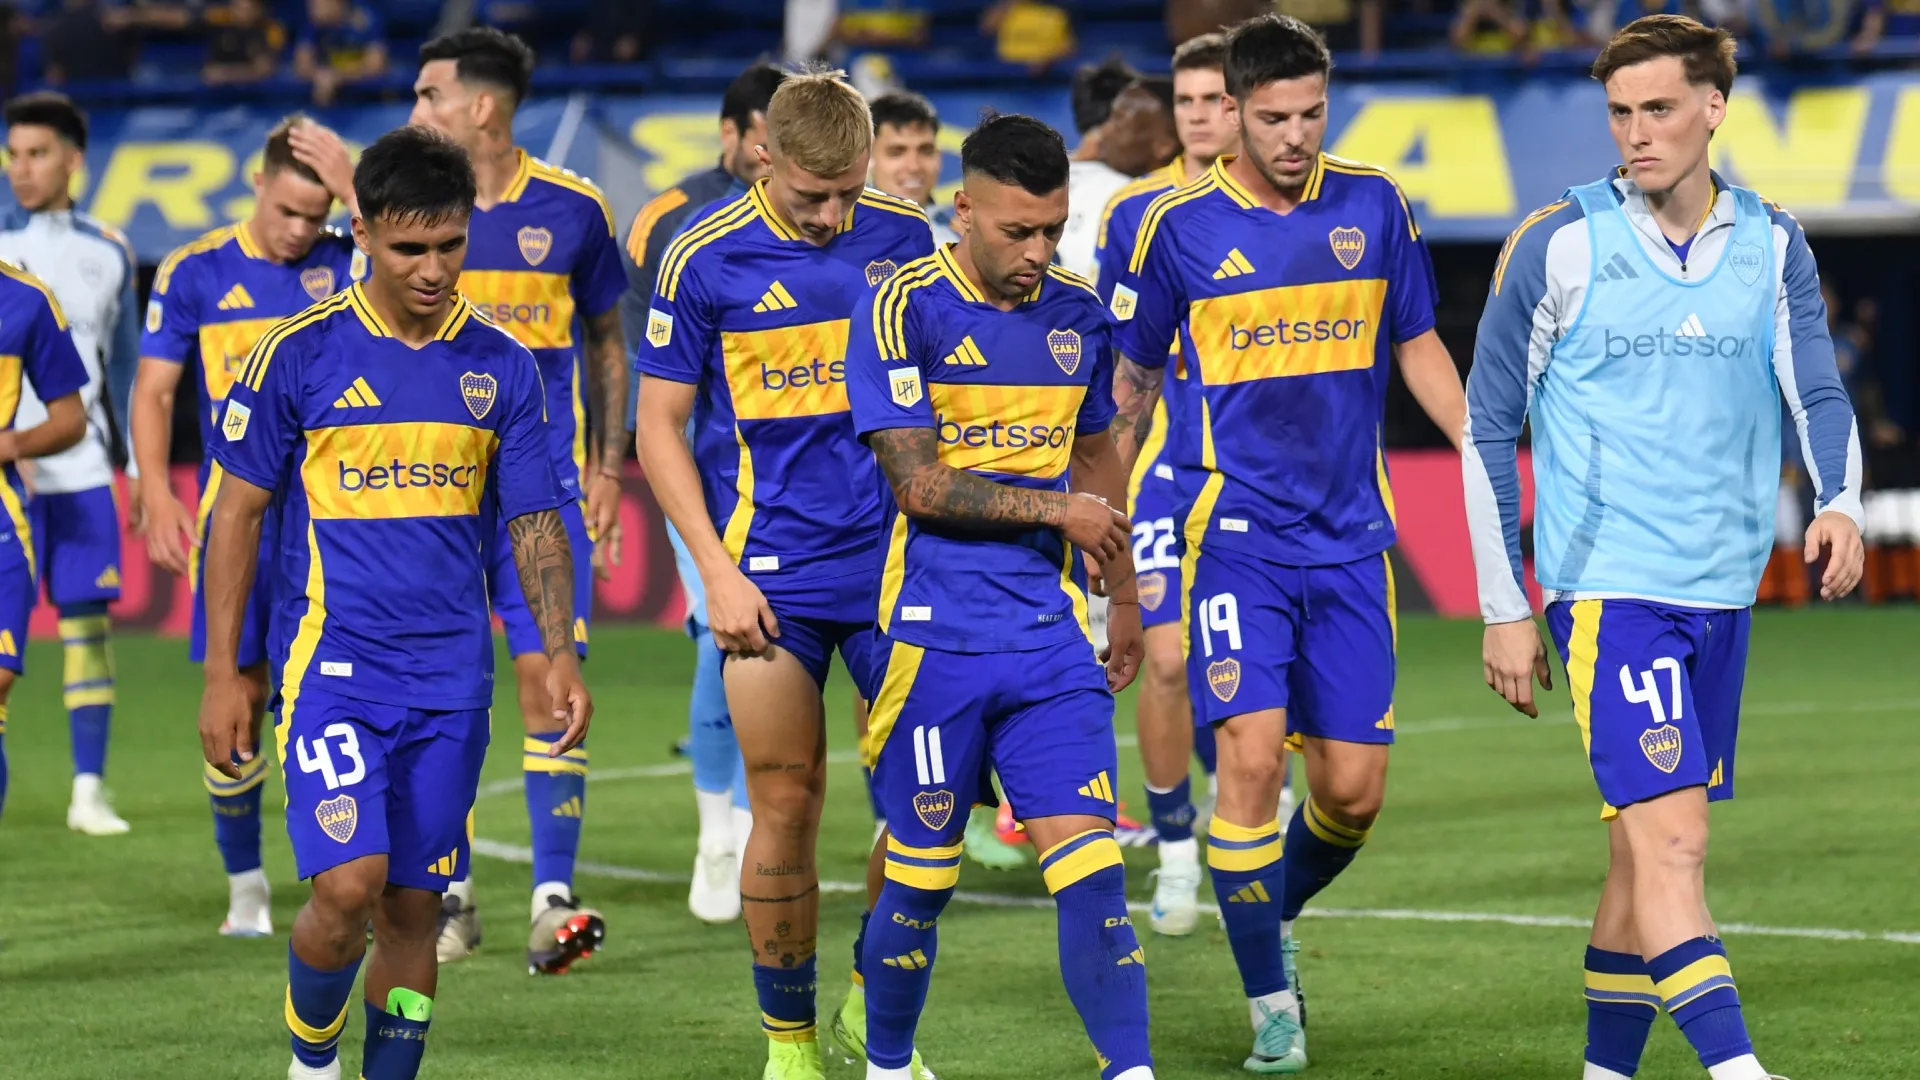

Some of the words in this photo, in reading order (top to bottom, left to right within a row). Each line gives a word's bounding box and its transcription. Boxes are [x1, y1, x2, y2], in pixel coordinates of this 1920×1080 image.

[1335, 241, 1361, 250] CABJ
[1732, 255, 1760, 266] CABJ
[474, 303, 550, 324] sson
[1230, 318, 1367, 350] betsson
[1605, 327, 1755, 359] betsson
[1053, 345, 1078, 354] CABJ
[761, 358, 846, 390] bets
[465, 387, 491, 399] CABJ
[1132, 516, 1180, 573] 22
[1198, 592, 1242, 657] 19
[1212, 672, 1237, 685] CABJ
[1619, 656, 1683, 723] 47
[296, 723, 366, 791] 43
[913, 725, 946, 785] 11
[1647, 739, 1677, 755] CABJ
[323, 809, 353, 826] CABJ
[920, 804, 949, 814] CABJ
